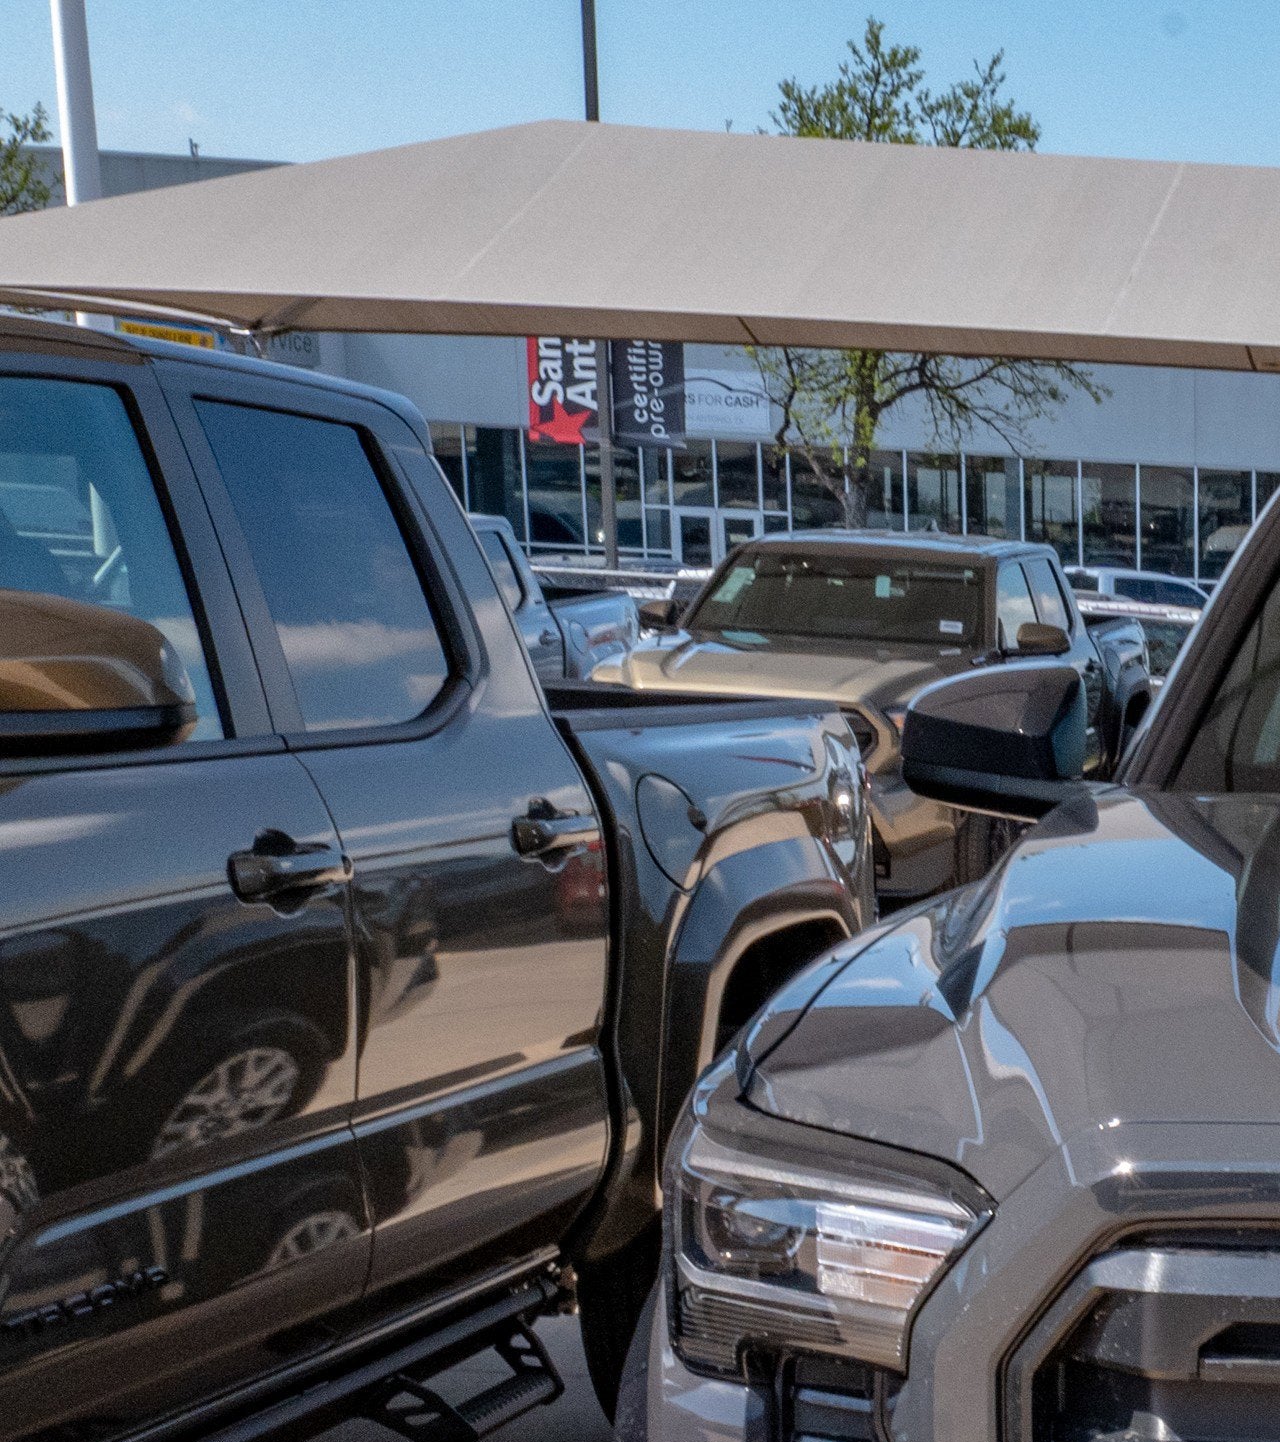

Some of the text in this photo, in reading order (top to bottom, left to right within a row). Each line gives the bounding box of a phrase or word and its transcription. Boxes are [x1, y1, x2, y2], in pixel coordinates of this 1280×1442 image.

[532, 337, 564, 406] San
[698, 394, 722, 406] FOR
[724, 395, 760, 408] CASH
